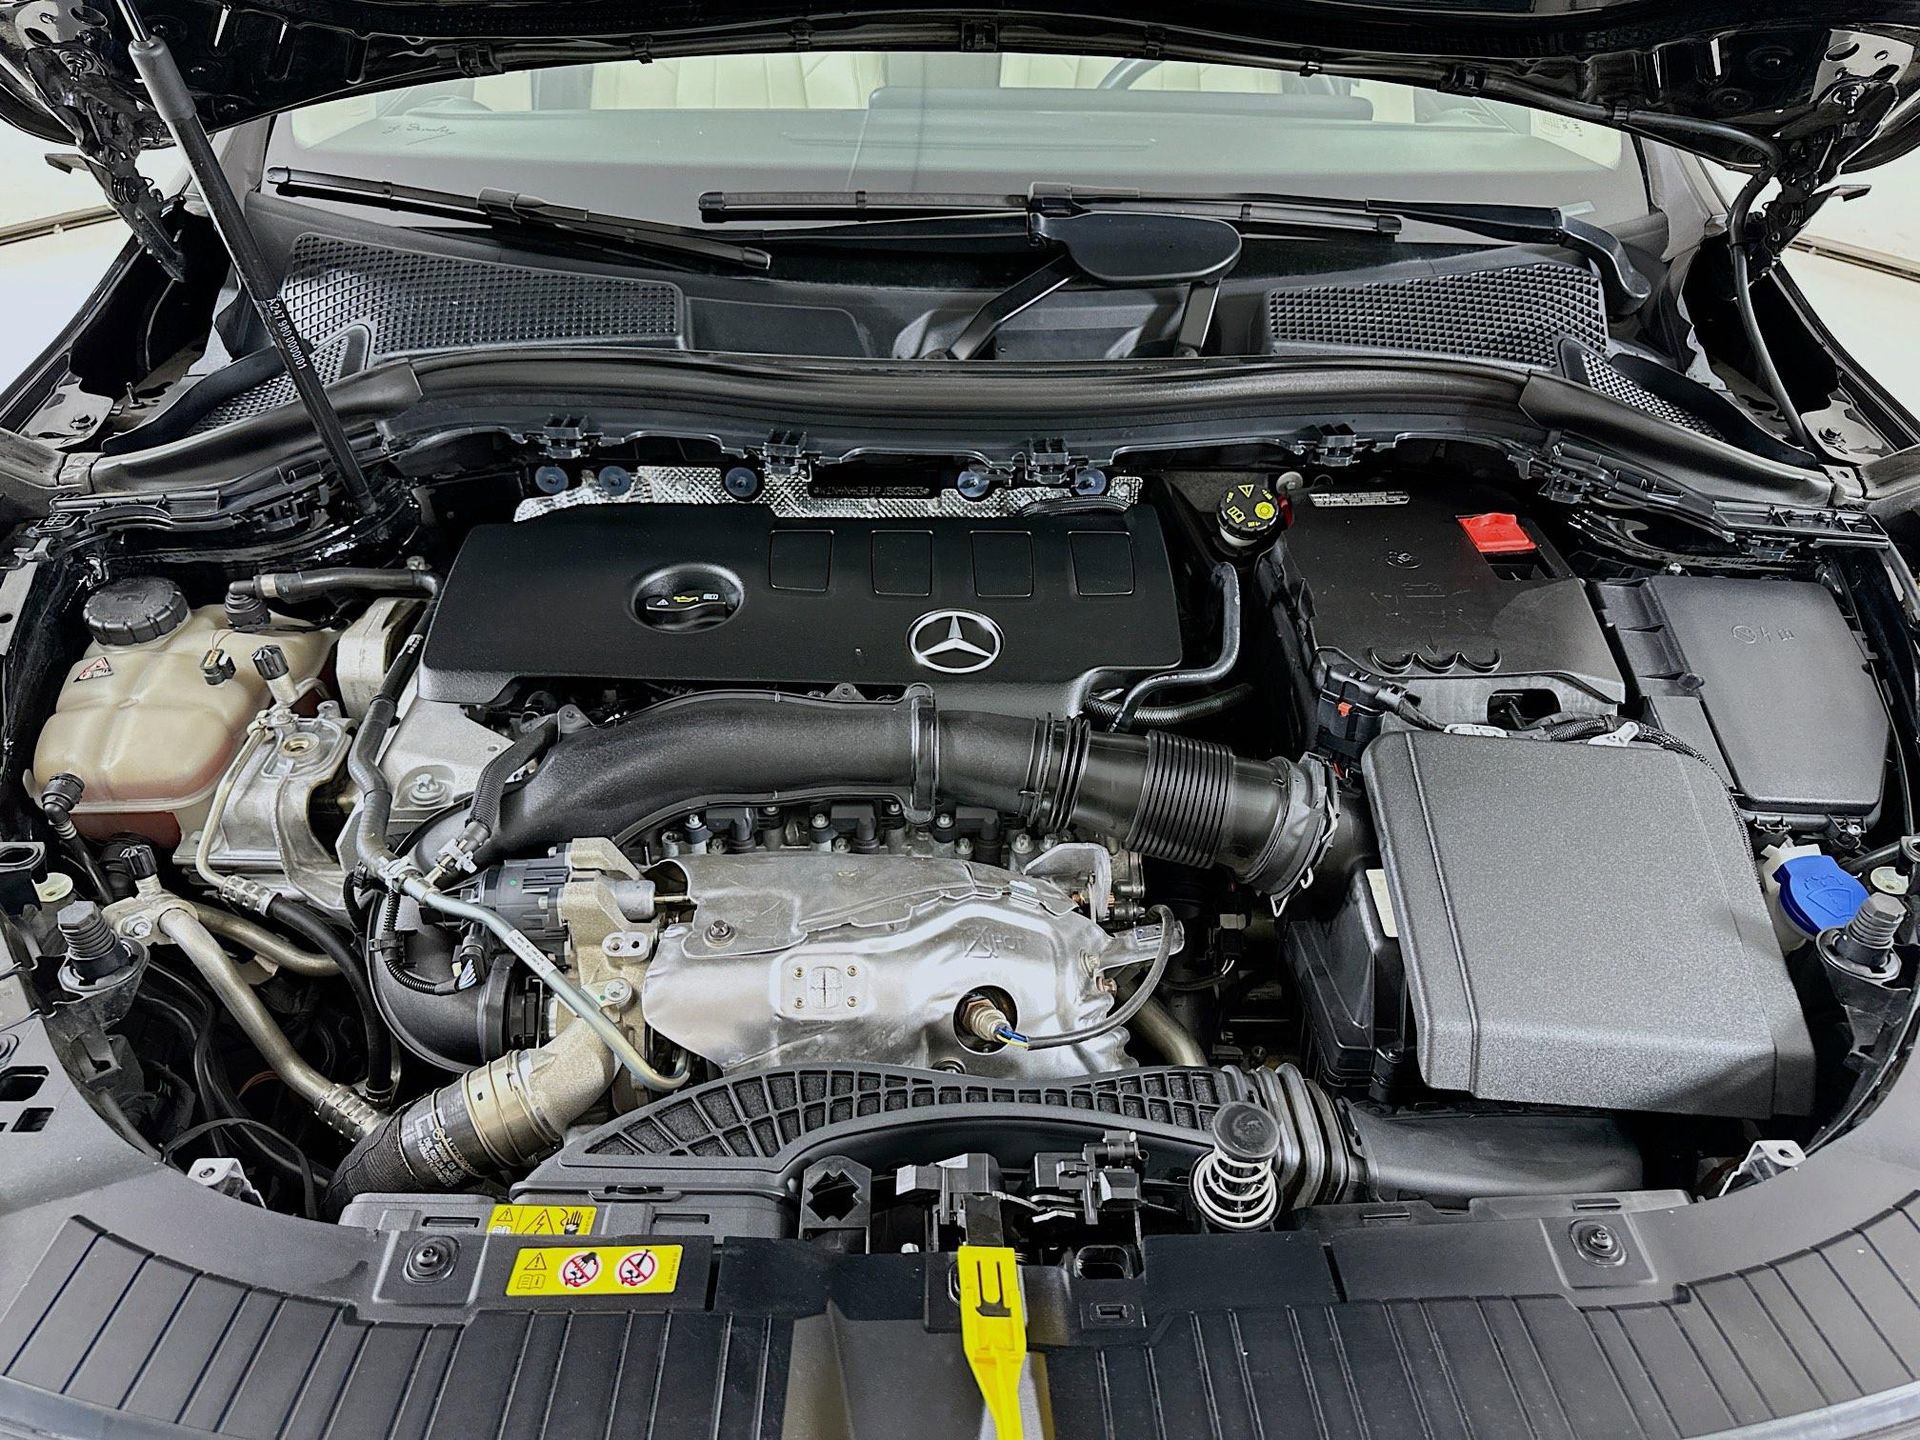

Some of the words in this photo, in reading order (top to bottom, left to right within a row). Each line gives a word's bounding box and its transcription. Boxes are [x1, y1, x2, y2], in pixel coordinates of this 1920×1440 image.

[267, 298, 286, 320] A247
[278, 320, 292, 337] 980
[286, 336, 308, 370] 0000/01
